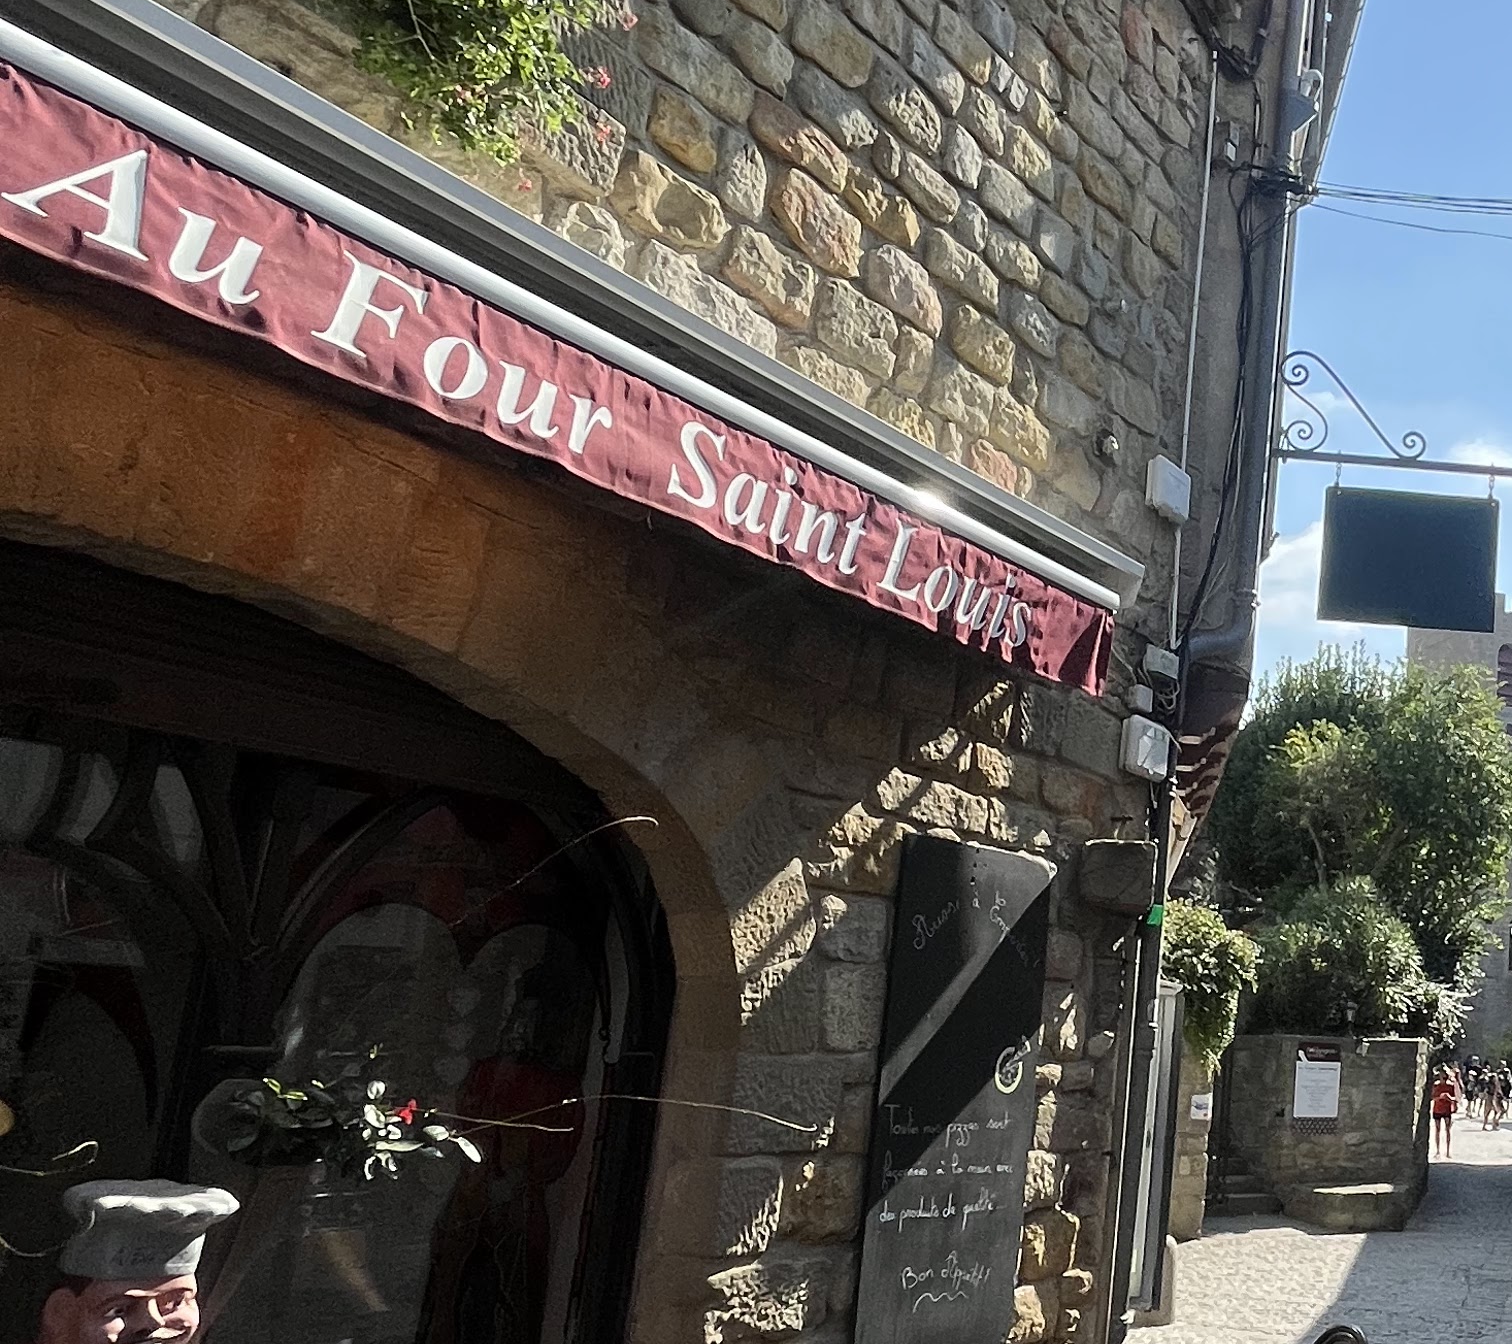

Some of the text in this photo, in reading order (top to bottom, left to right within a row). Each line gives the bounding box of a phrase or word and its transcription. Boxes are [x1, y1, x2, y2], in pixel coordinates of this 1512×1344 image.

[1, 149, 1031, 646] Au Four Saint Louis
[901, 1267, 935, 1291] Bon
